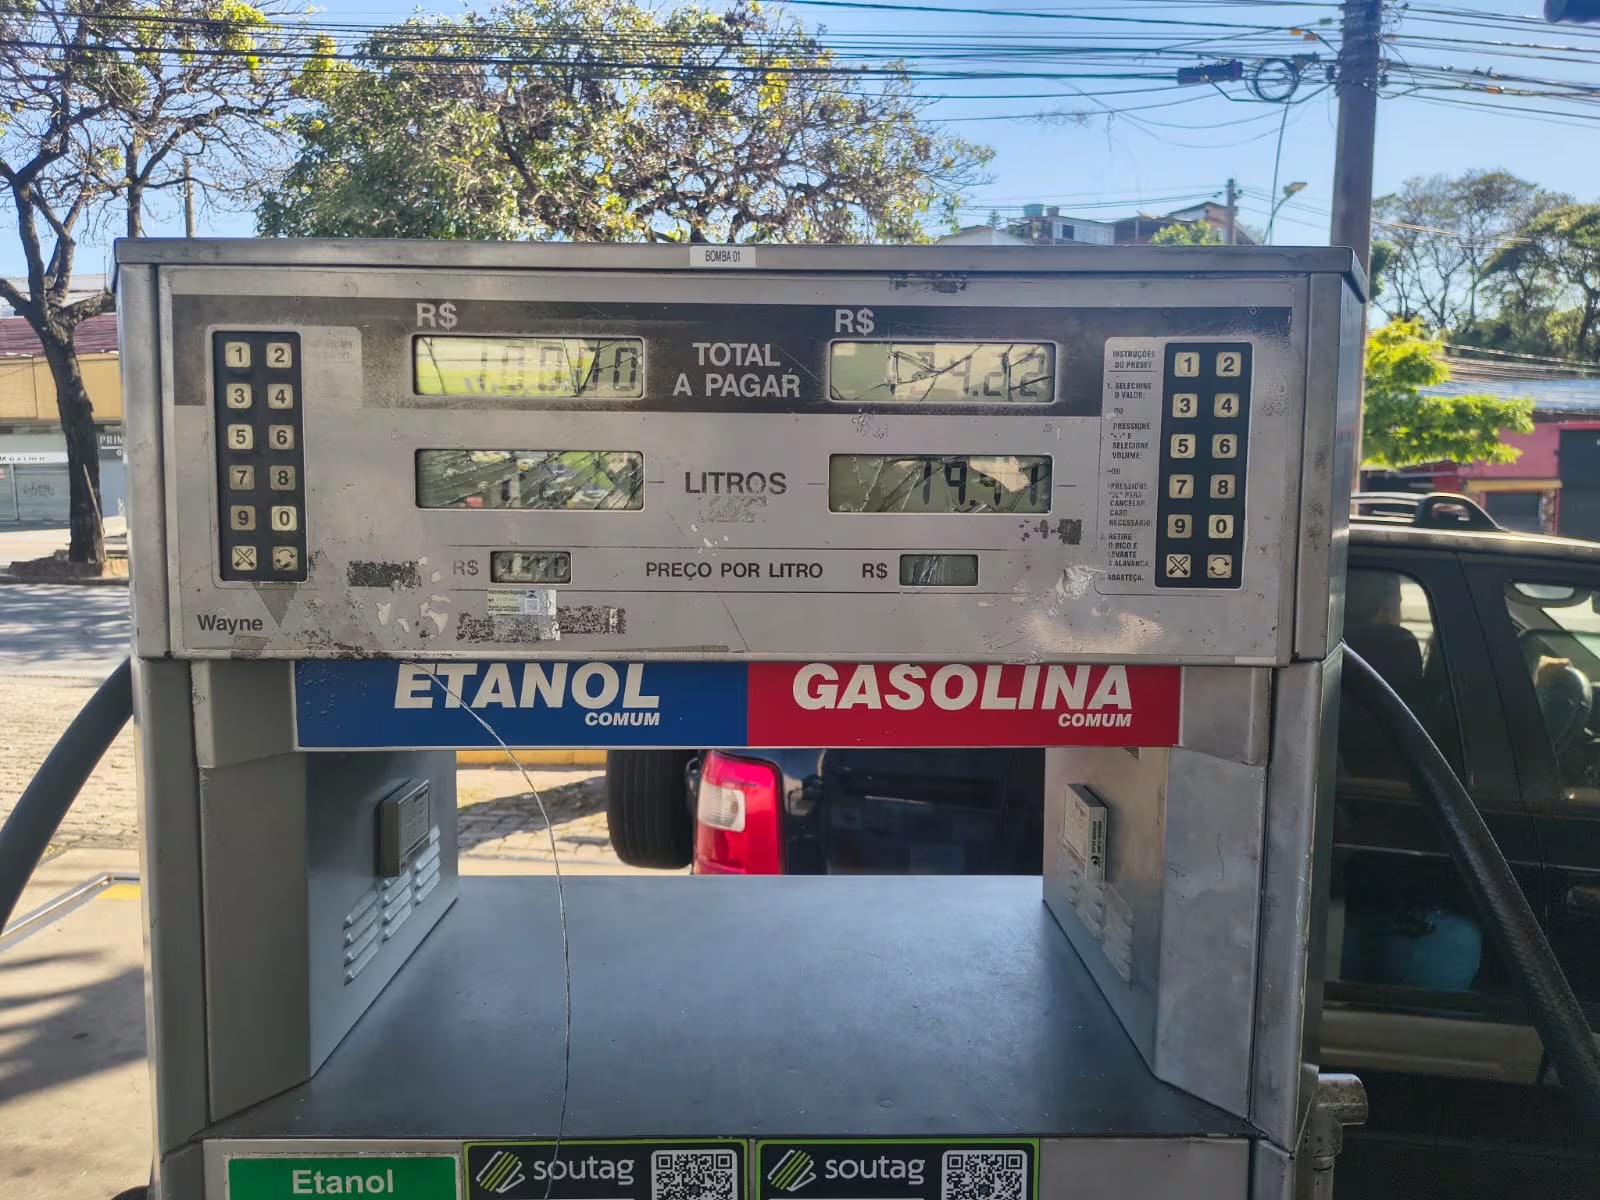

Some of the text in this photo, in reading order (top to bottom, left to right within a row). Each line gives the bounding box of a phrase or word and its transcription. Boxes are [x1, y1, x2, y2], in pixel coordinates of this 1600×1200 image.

[705, 250, 741, 262] BOMBA 01
[416, 301, 458, 331] R$
[834, 307, 875, 335] R$
[234, 346, 243, 363] 1
[274, 348, 286, 363] 2
[692, 342, 781, 367] TOTAL
[1112, 349, 1156, 359] INSTRUÇÕES
[1114, 361, 1152, 369] DO PRESET
[1184, 356, 1192, 372] 1
[1222, 356, 1234, 372] 2
[672, 373, 800, 398] A PAGAR
[1106, 382, 1152, 390] 1. SELECIONE
[234, 388, 245, 404] 3
[275, 389, 286, 404] 4
[1180, 398, 1191, 413] 3
[1221, 398, 1232, 413] 4
[1113, 422, 1151, 430] PRESSIONE
[236, 429, 246, 444] 5
[276, 429, 288, 445] 6
[1177, 438, 1189, 454] 5
[1219, 438, 1231, 454] 6
[236, 470, 247, 485] 7
[278, 470, 289, 486] 8
[685, 472, 787, 495] LITROS
[1176, 480, 1188, 494] 7
[1217, 480, 1229, 495] 8
[238, 510, 249, 526] 9
[279, 510, 291, 526] 0
[1174, 518, 1186, 534] 9
[1216, 518, 1227, 534] 0
[453, 560, 479, 576] R$
[646, 562, 823, 581] PREÇO POR LITRO
[862, 562, 888, 581] R$
[197, 614, 264, 636] Wayne
[394, 662, 660, 709] ETANOL
[793, 662, 1133, 711] GASOLINA
[585, 712, 660, 726] COMUM
[1058, 713, 1132, 728] COMUM
[533, 1156, 635, 1186] soutag
[825, 1155, 926, 1185] soutag
[292, 1169, 394, 1194] Etanol
